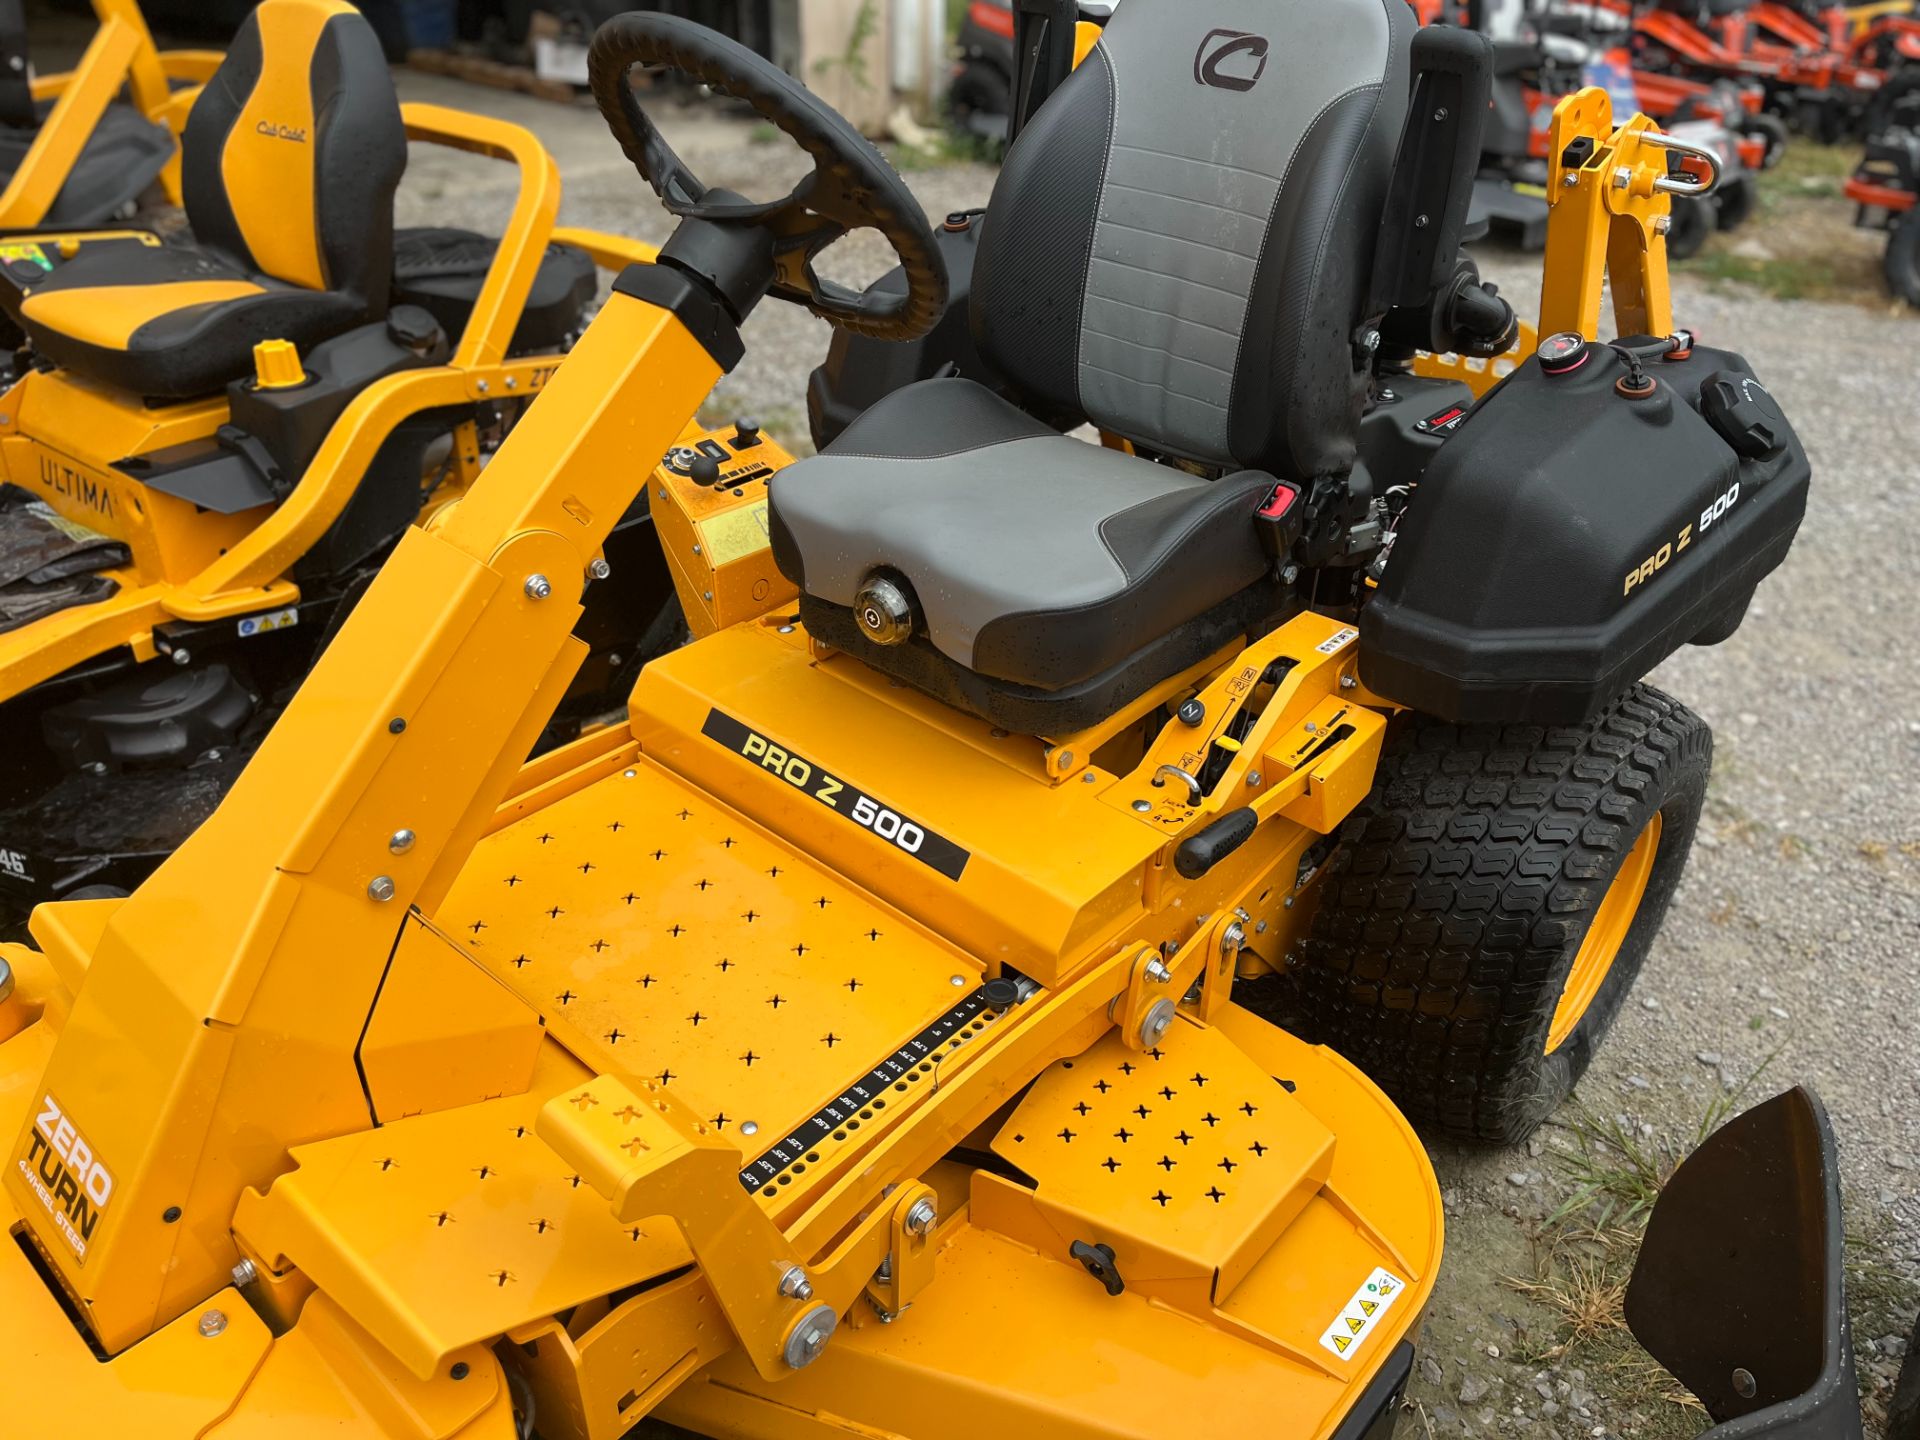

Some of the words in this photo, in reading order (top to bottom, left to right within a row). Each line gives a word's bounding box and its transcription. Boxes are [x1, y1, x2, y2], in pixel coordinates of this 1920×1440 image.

[530, 366, 559, 388] ZT
[40, 454, 114, 520] ULTIMA
[1623, 542, 1672, 597] PRO
[1676, 523, 1693, 553] Z
[1699, 482, 1740, 532] 500
[742, 733, 812, 788] PRO
[815, 775, 844, 807] Z
[851, 795, 925, 854] 500
[898, 1050, 917, 1063] 2.75"
[885, 1060, 904, 1073] 3.75"
[873, 1070, 892, 1082] 4.75"
[839, 1097, 858, 1109] 2.50"
[825, 1108, 844, 1121] 3.50"
[811, 1117, 831, 1130] 4.50"
[36, 1094, 113, 1207] ZERO
[785, 1138, 804, 1151] 1.25"
[771, 1149, 791, 1163] 2.25"
[757, 1160, 776, 1174] 3.25"
[28, 1126, 99, 1242] TURN
[741, 1172, 760, 1186] 4.25"
[18, 1160, 55, 1215] 4-WHEEL
[55, 1210, 87, 1257] STEER
